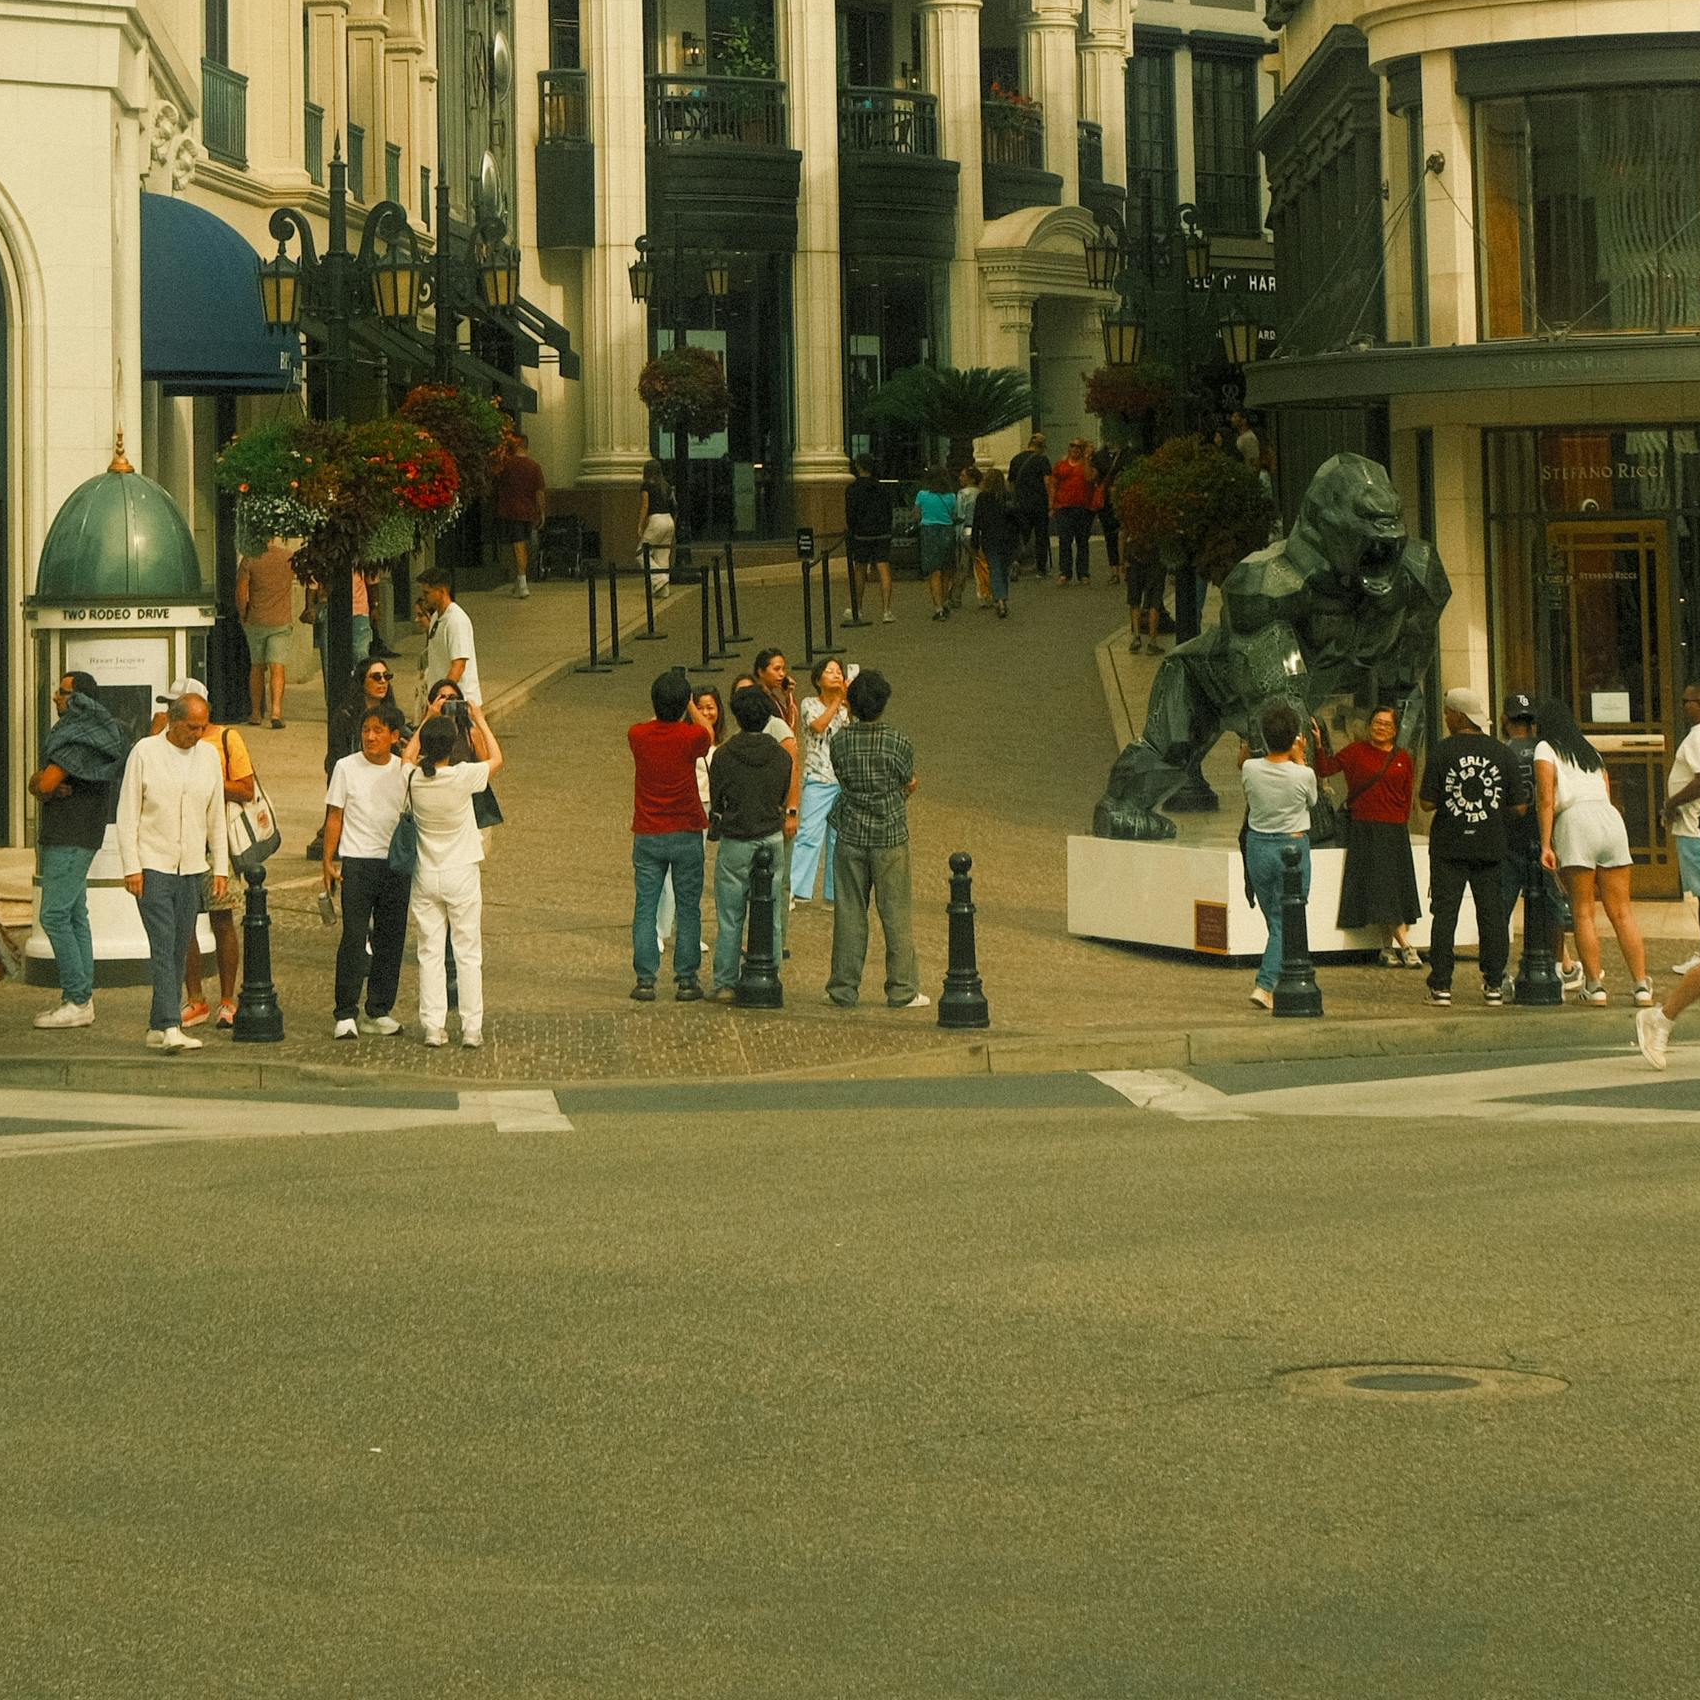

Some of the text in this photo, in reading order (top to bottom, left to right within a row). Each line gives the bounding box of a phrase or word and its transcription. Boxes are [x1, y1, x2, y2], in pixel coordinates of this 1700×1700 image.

[63, 608, 170, 621] TWO RODEO DRIVE
